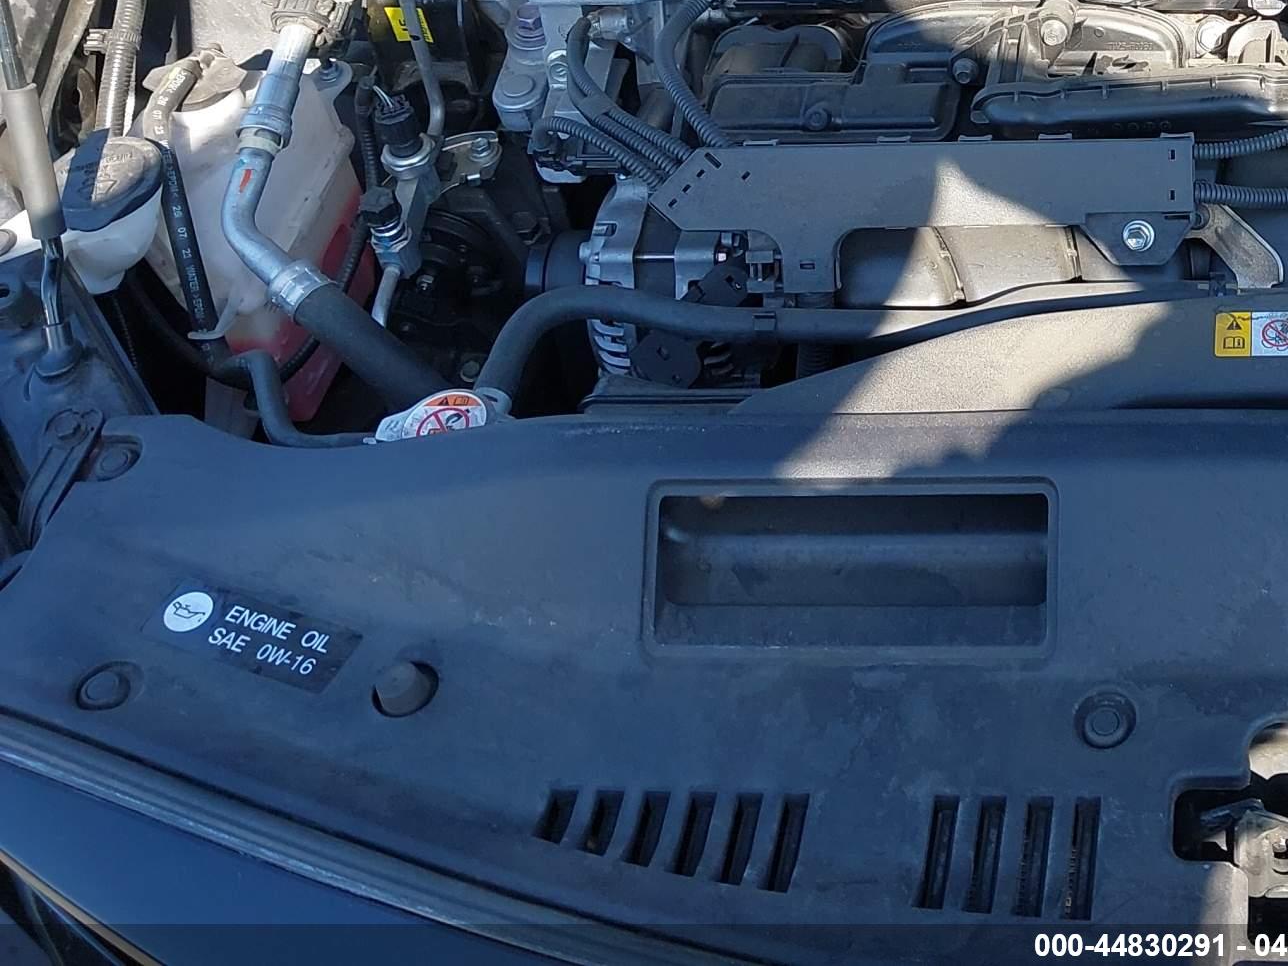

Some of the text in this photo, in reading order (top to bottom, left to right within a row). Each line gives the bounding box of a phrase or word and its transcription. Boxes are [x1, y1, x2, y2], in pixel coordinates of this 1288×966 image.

[208, 627, 317, 675] SAE 0W-16
[224, 605, 330, 653] ENGINE OIL
